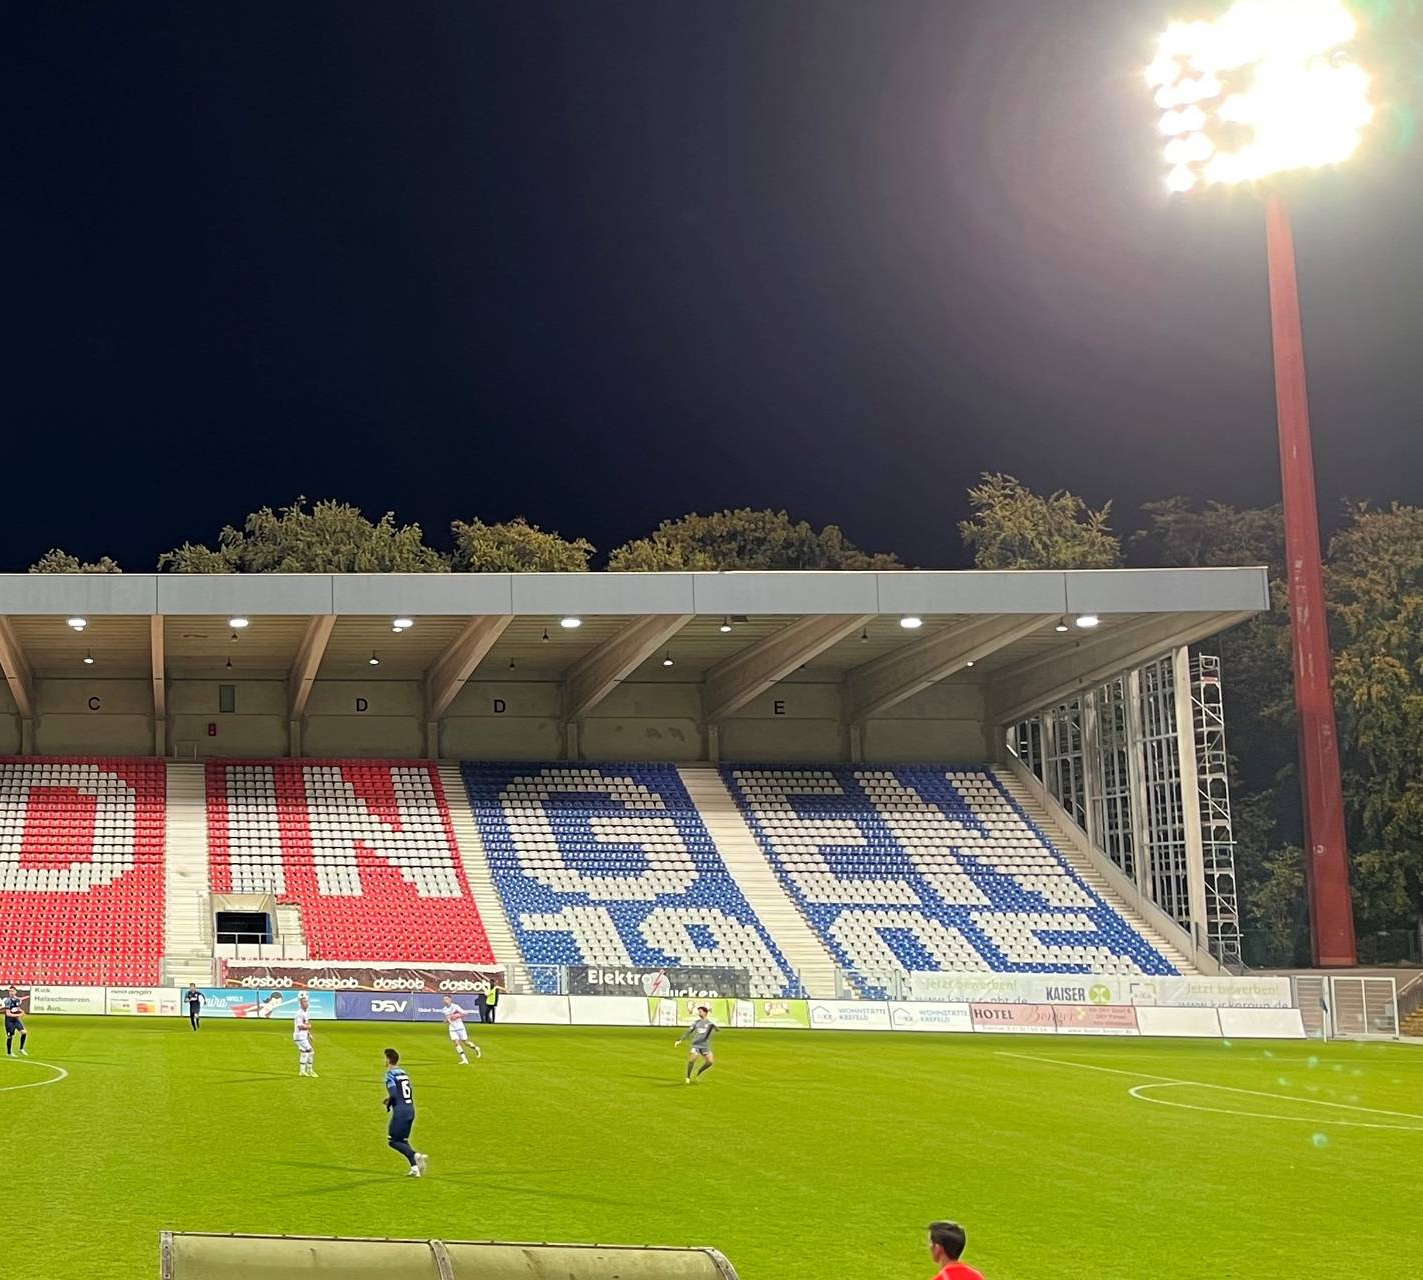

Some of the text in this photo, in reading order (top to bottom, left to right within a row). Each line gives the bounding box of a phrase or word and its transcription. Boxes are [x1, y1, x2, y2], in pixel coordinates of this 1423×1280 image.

[88, 696, 101, 711] C
[355, 698, 369, 712] D
[493, 699, 506, 714] D
[774, 700, 785, 715] E
[587, 968, 652, 986] Elektro
[1045, 986, 1086, 1001] KAISER
[371, 1000, 408, 1013] DSV
[974, 1008, 1015, 1020] HOTEL
[401, 1080, 412, 1099] 6
